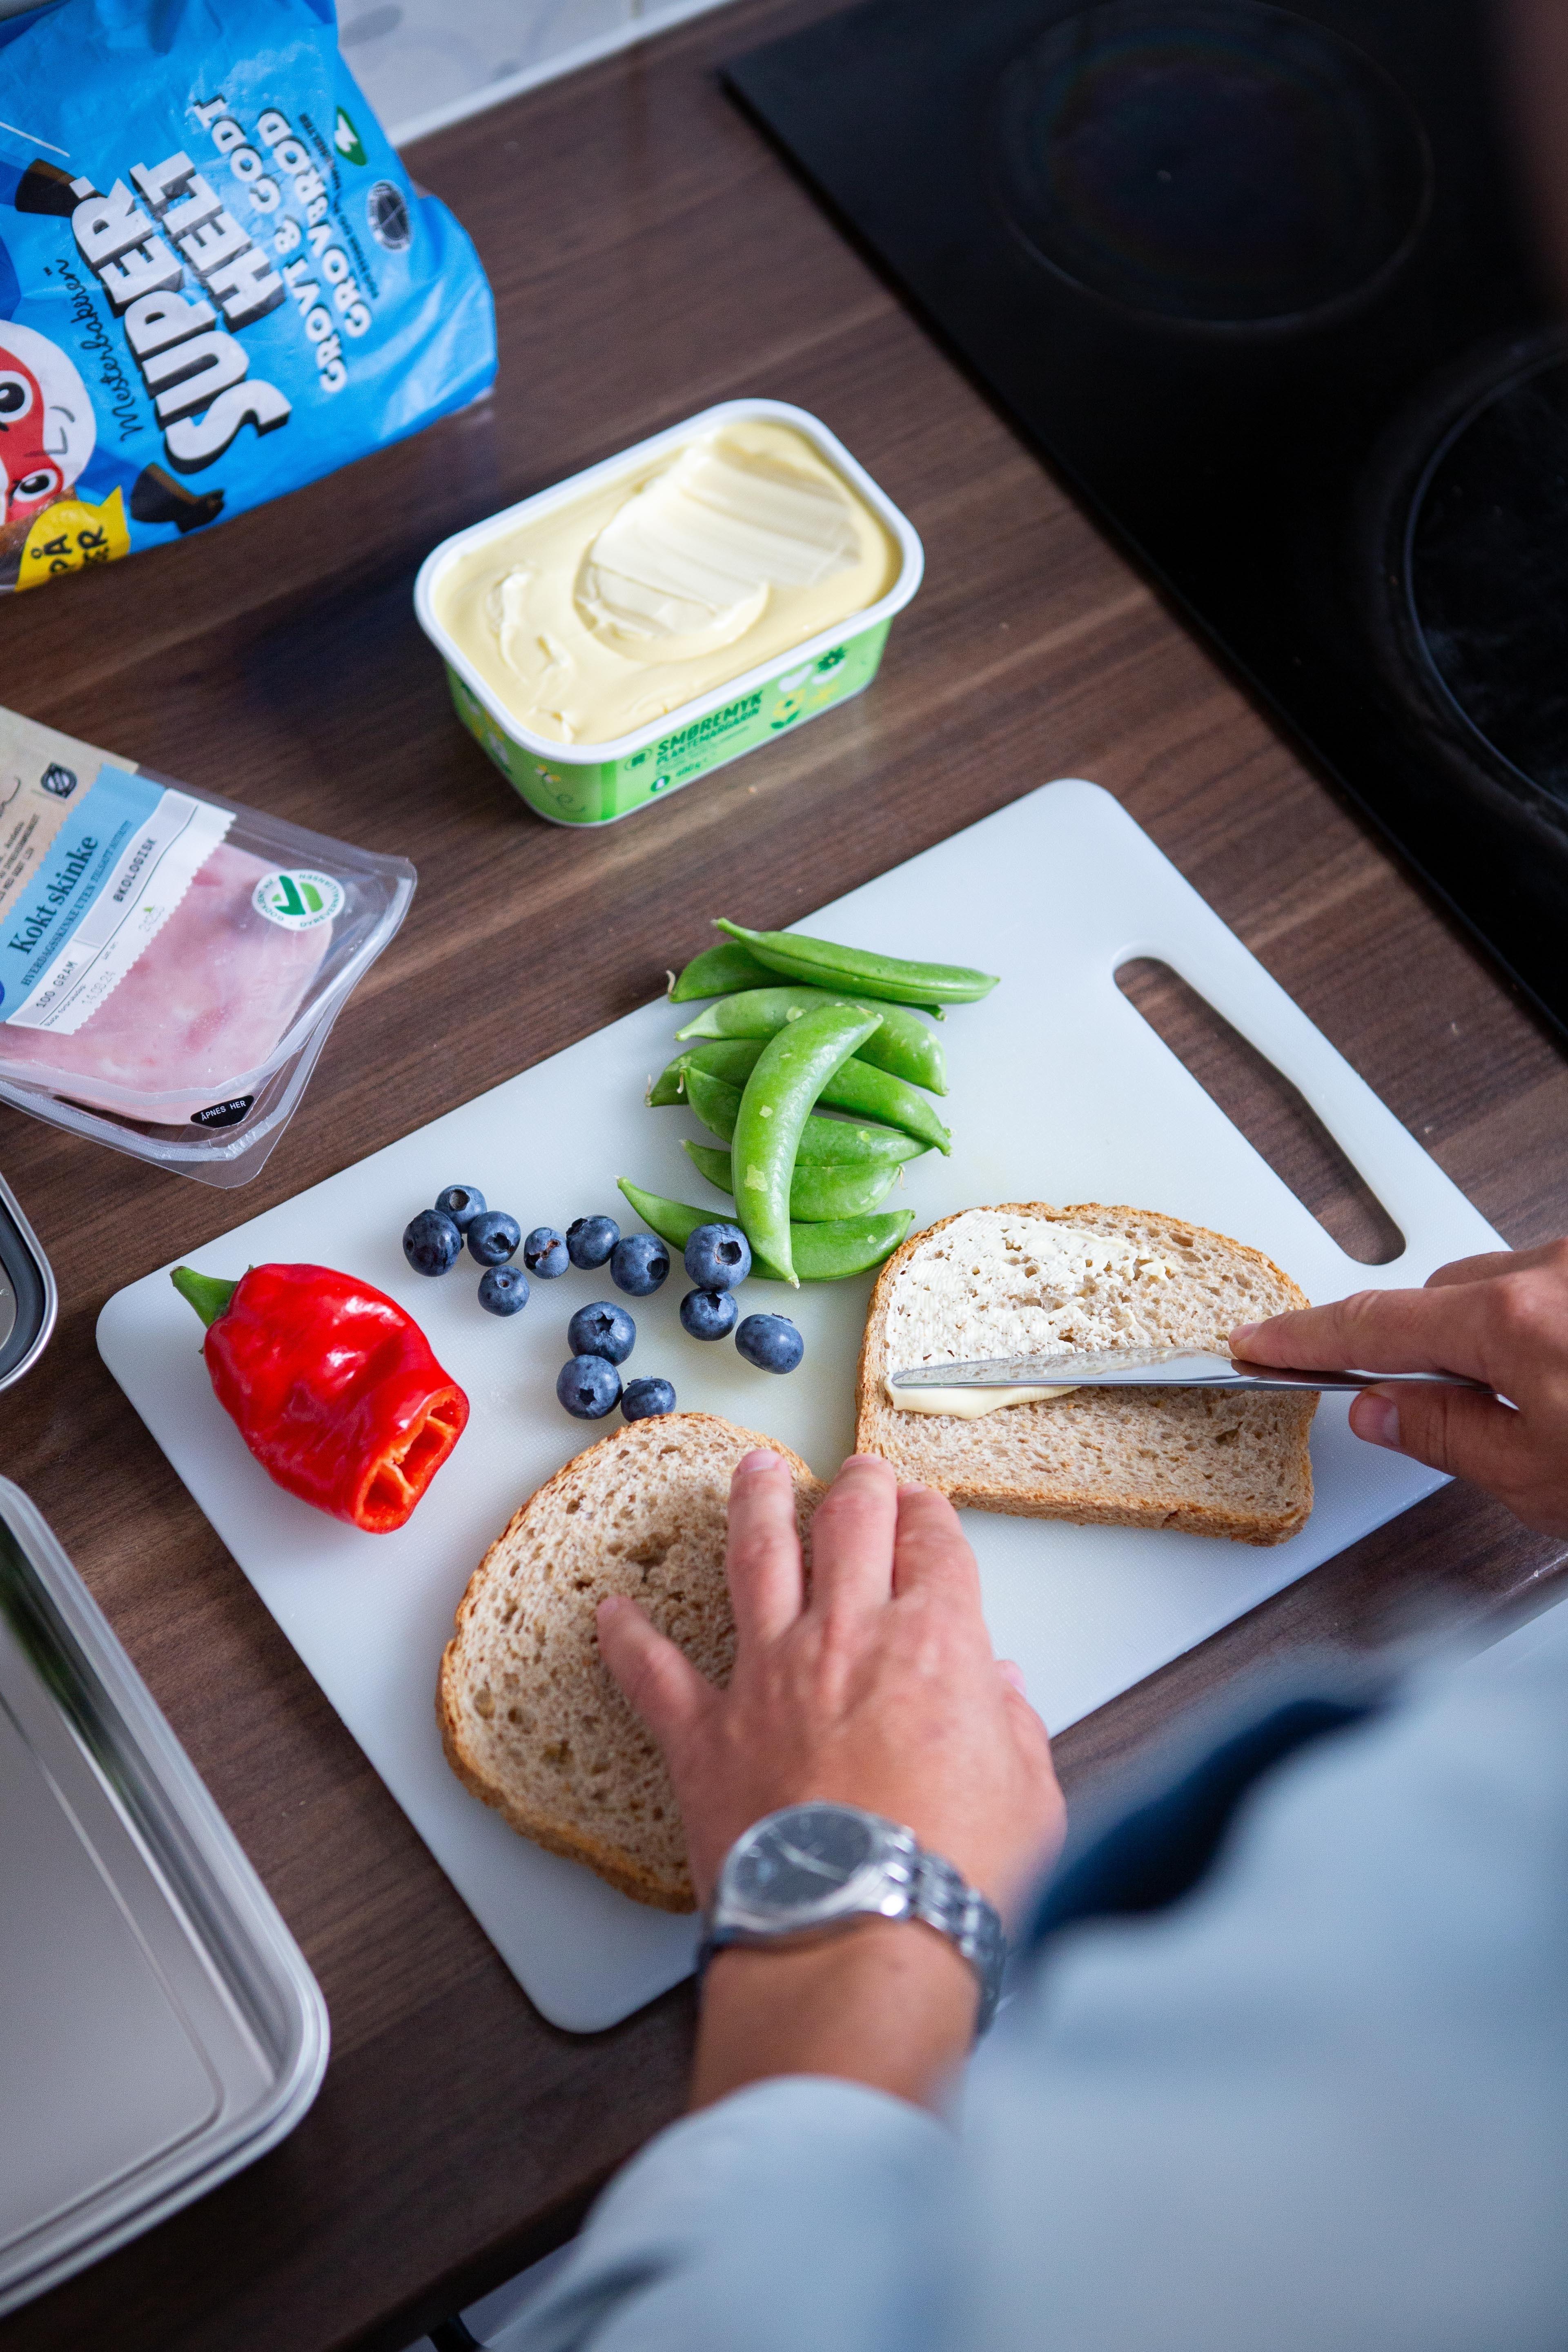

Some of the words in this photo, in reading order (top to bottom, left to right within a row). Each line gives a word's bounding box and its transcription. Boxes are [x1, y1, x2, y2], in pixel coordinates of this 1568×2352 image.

[193, 93, 281, 214] GODT
[129, 150, 285, 327] HELT
[274, 215, 302, 254] &
[55, 258, 144, 443] Mesterbakeren
[283, 254, 347, 393] GROVT
[657, 689, 764, 756] SMØREMYK
[7, 904, 57, 954] Kokt
[45, 836, 98, 906] skinke
[113, 837, 157, 902] ØKOLOGISK
[36, 991, 56, 1008] 100
[53, 961, 78, 987] GRAM
[200, 1106, 226, 1121] ÅPNES
[229, 1100, 246, 1110] HER
